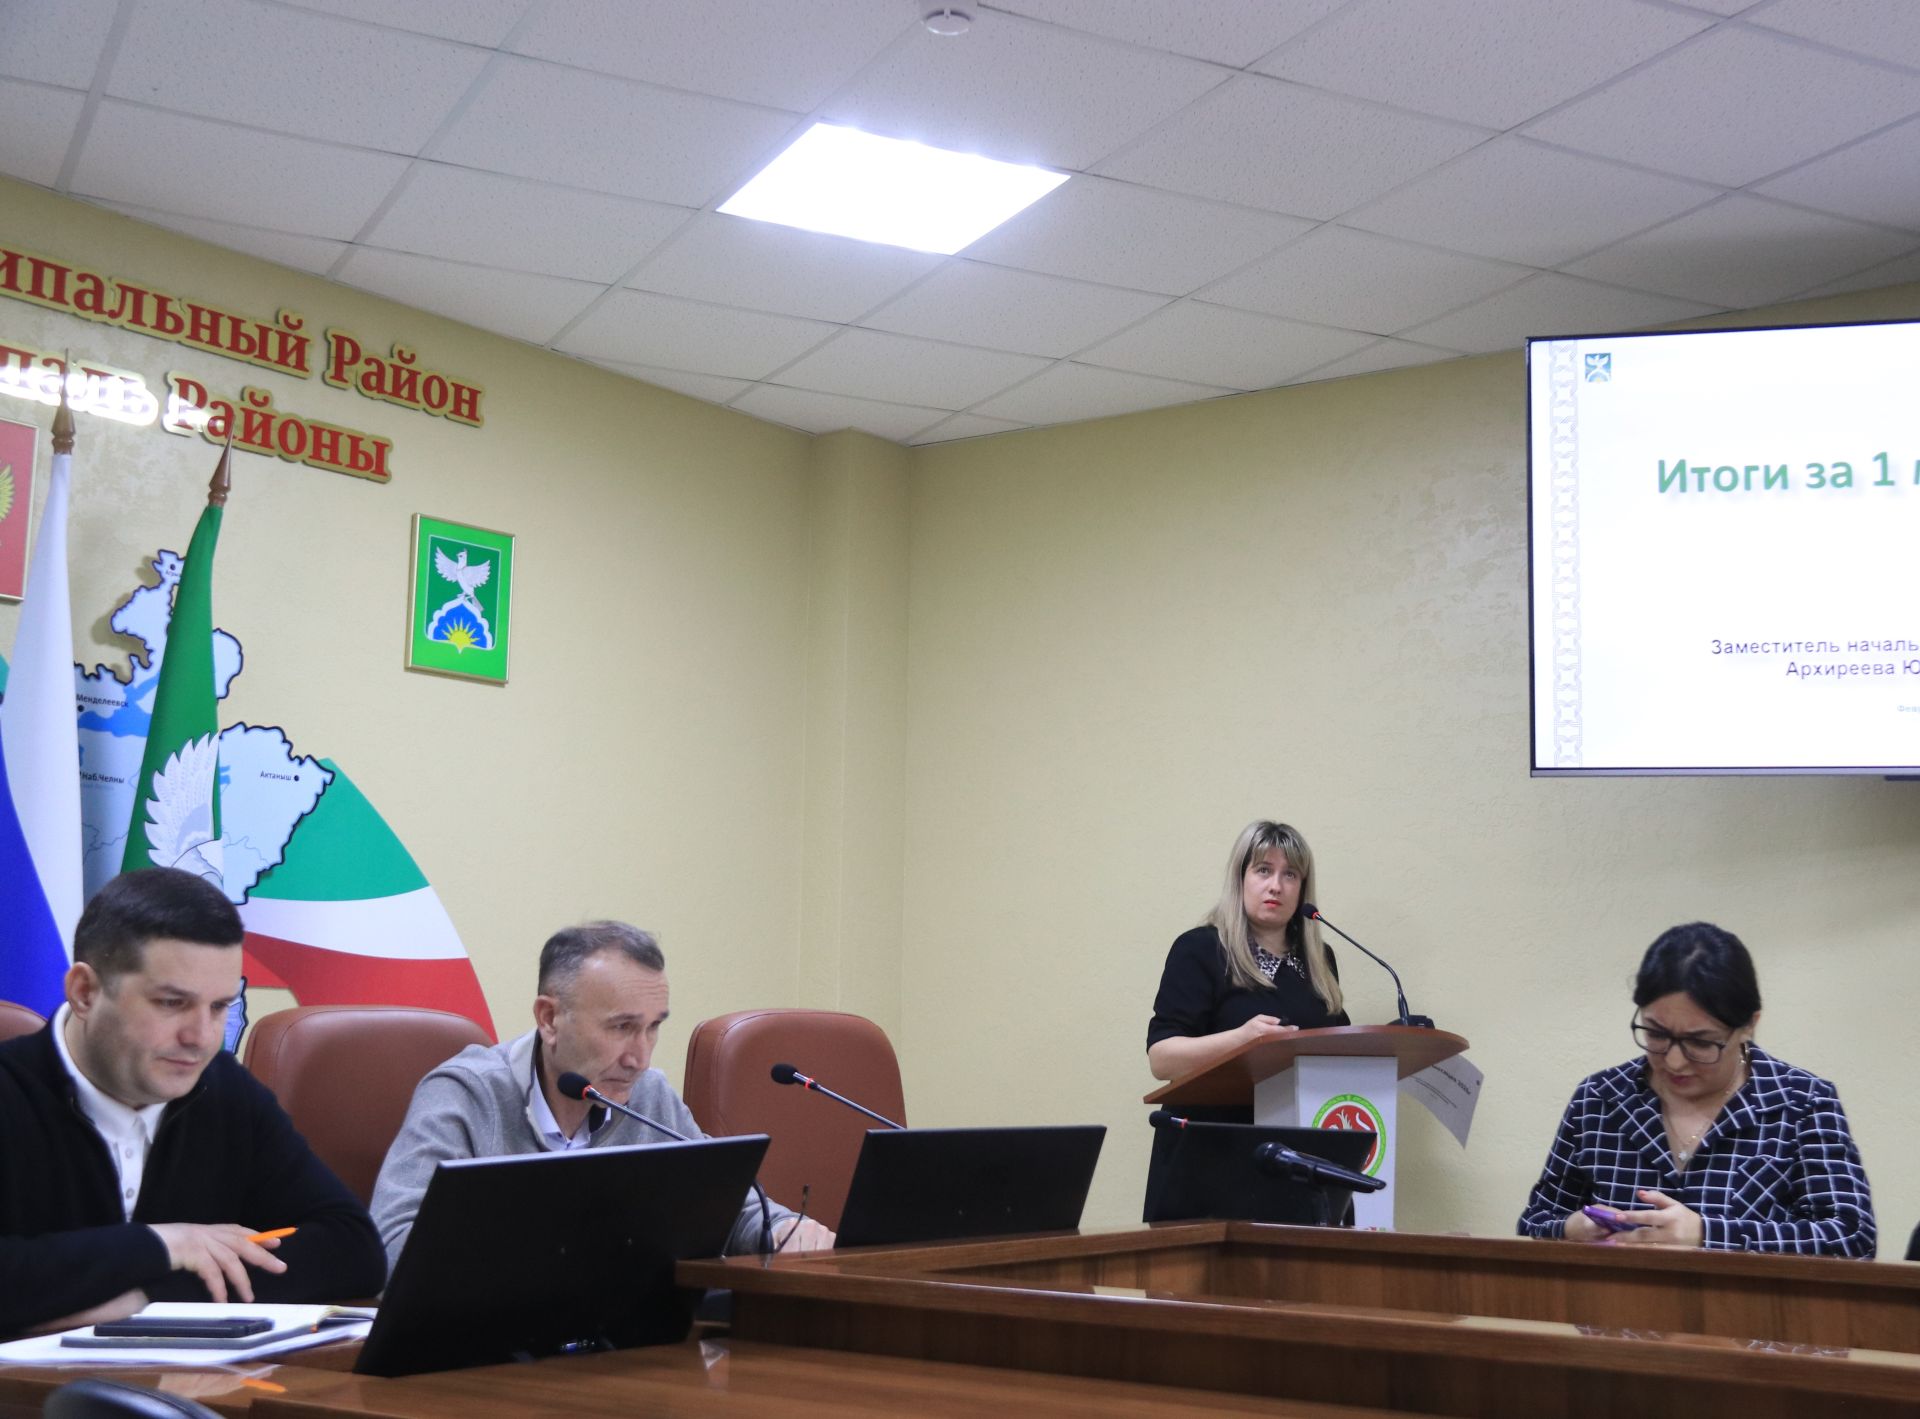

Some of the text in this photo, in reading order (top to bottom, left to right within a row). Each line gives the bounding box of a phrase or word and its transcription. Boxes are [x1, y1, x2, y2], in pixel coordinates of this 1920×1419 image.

[331, 334, 483, 422] Район
[173, 377, 391, 478] Районы
[1657, 459, 1790, 494] Итоги
[1805, 460, 1854, 488] за
[1872, 451, 1895, 486] 1
[1711, 639, 1920, 655] Заместитель началь
[1785, 661, 1896, 680] Архиреева
